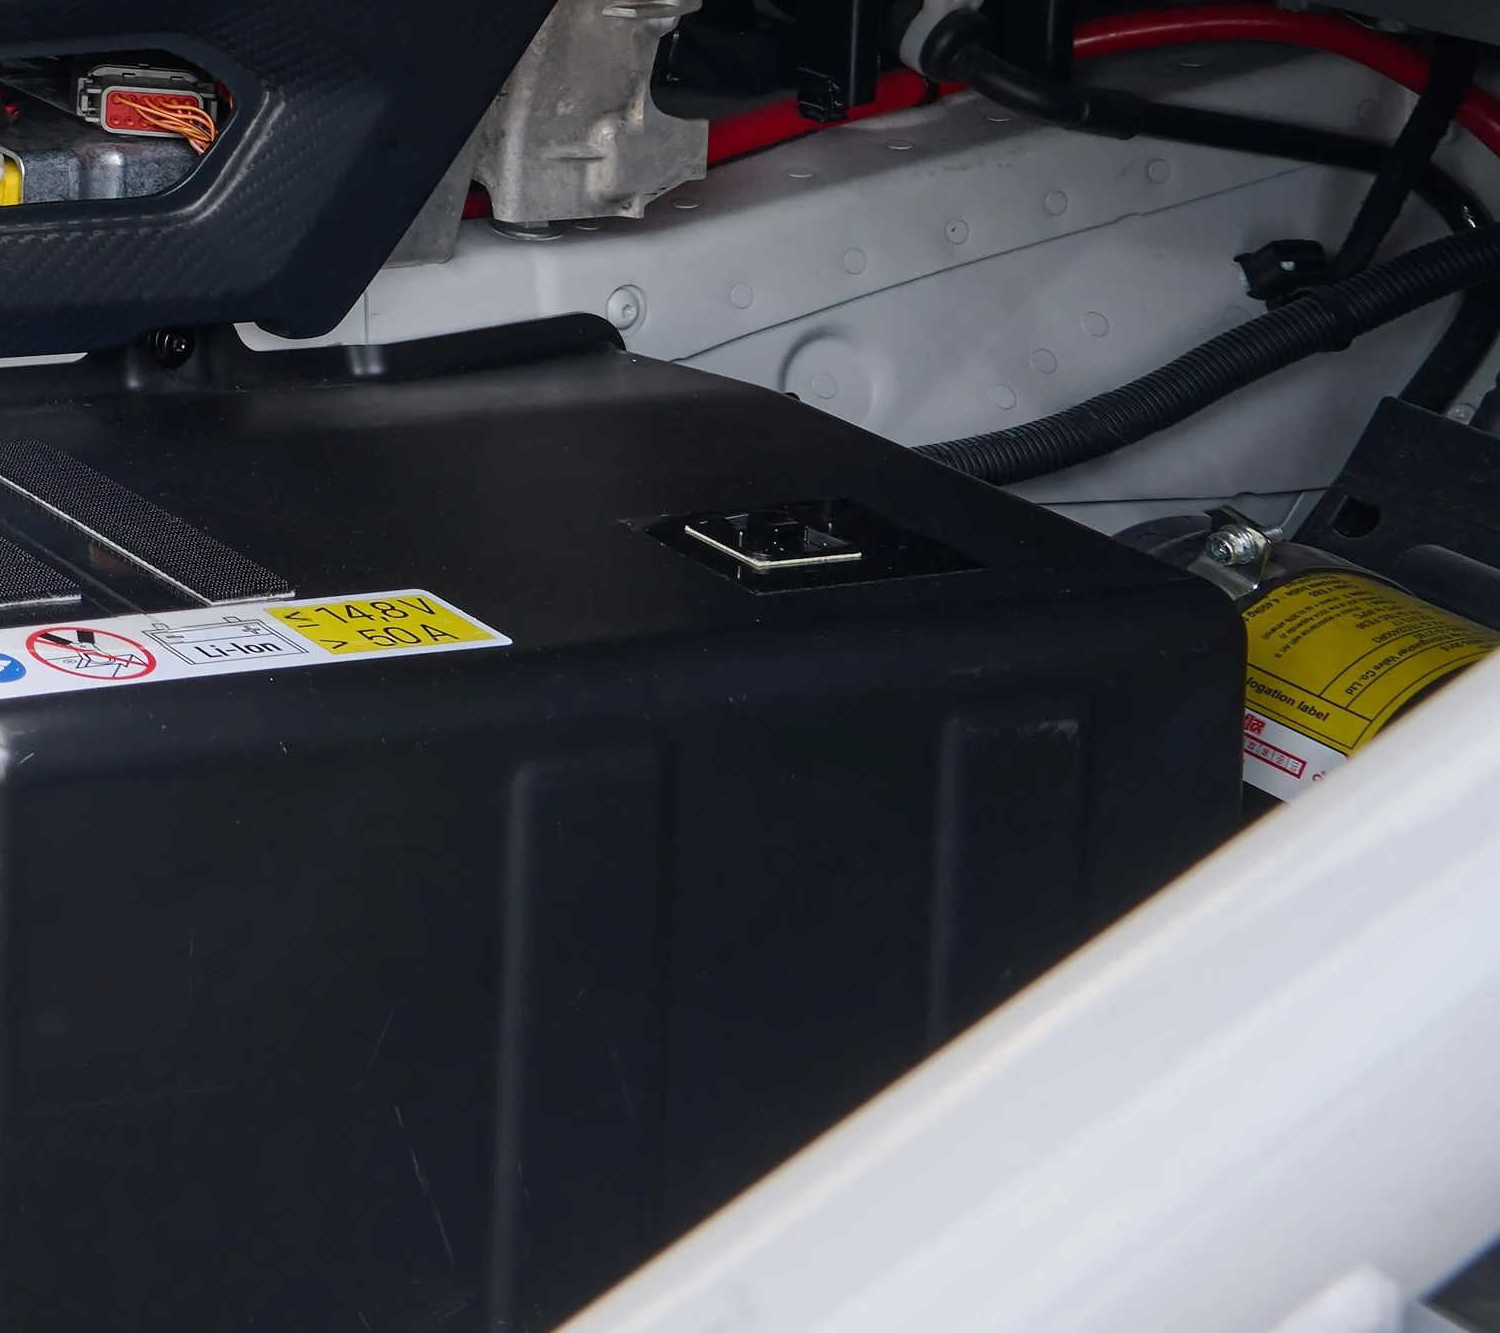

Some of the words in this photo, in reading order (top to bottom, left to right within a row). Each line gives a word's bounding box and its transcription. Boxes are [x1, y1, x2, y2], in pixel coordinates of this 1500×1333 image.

[194, 639, 283, 661] Li-Ion
[1343, 679, 1366, 697] Ltd
[1298, 698, 1331, 723] label
